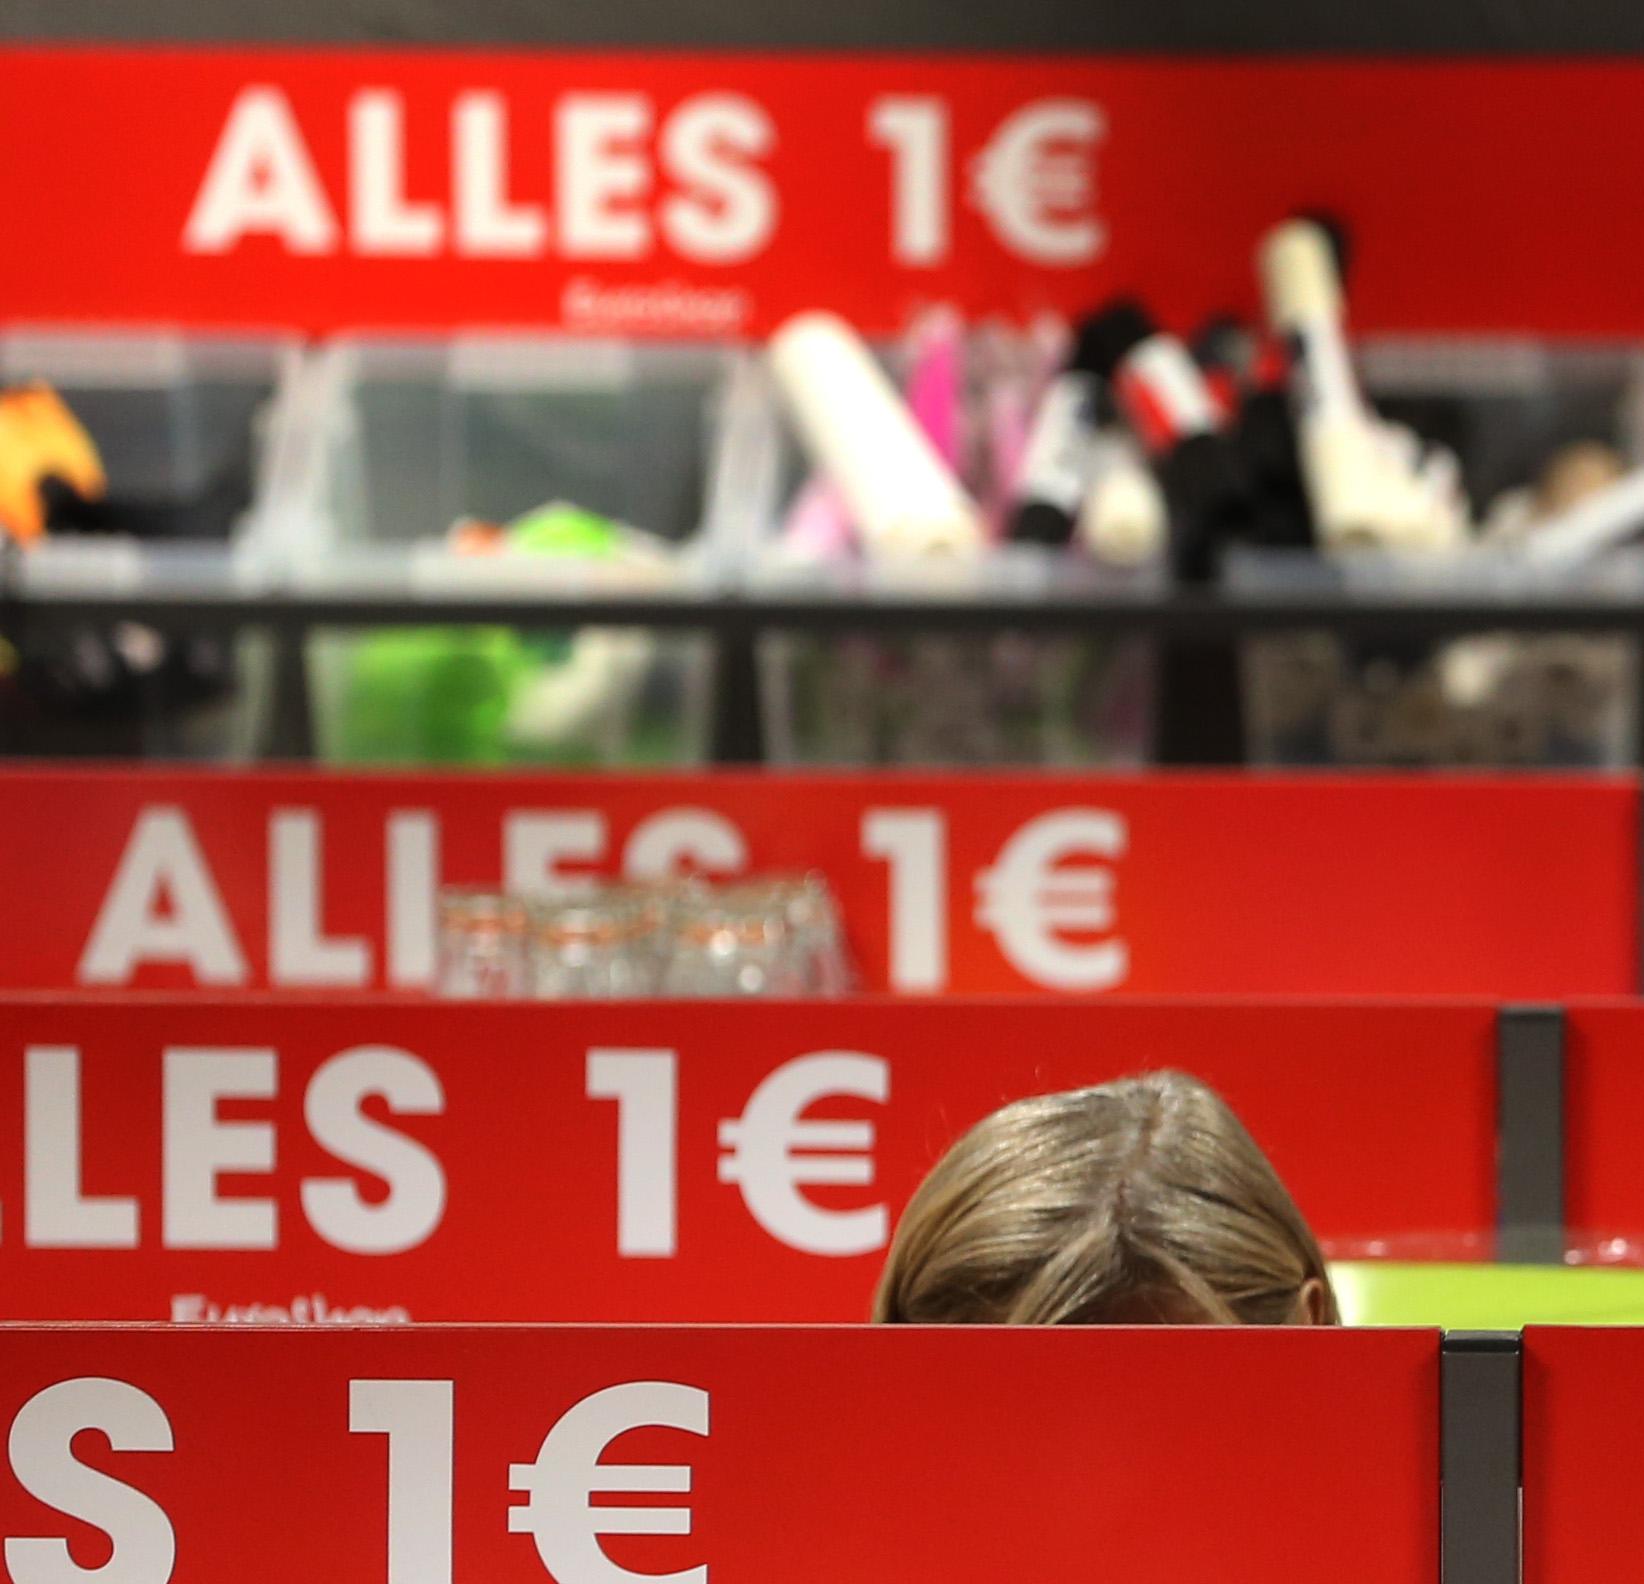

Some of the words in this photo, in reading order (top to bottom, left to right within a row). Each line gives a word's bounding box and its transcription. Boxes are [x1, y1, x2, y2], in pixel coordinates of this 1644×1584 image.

[185, 88, 776, 262] ALLES
[868, 97, 1106, 266] 1€
[860, 808, 1129, 996] 1€
[585, 1048, 890, 1258] 1€
